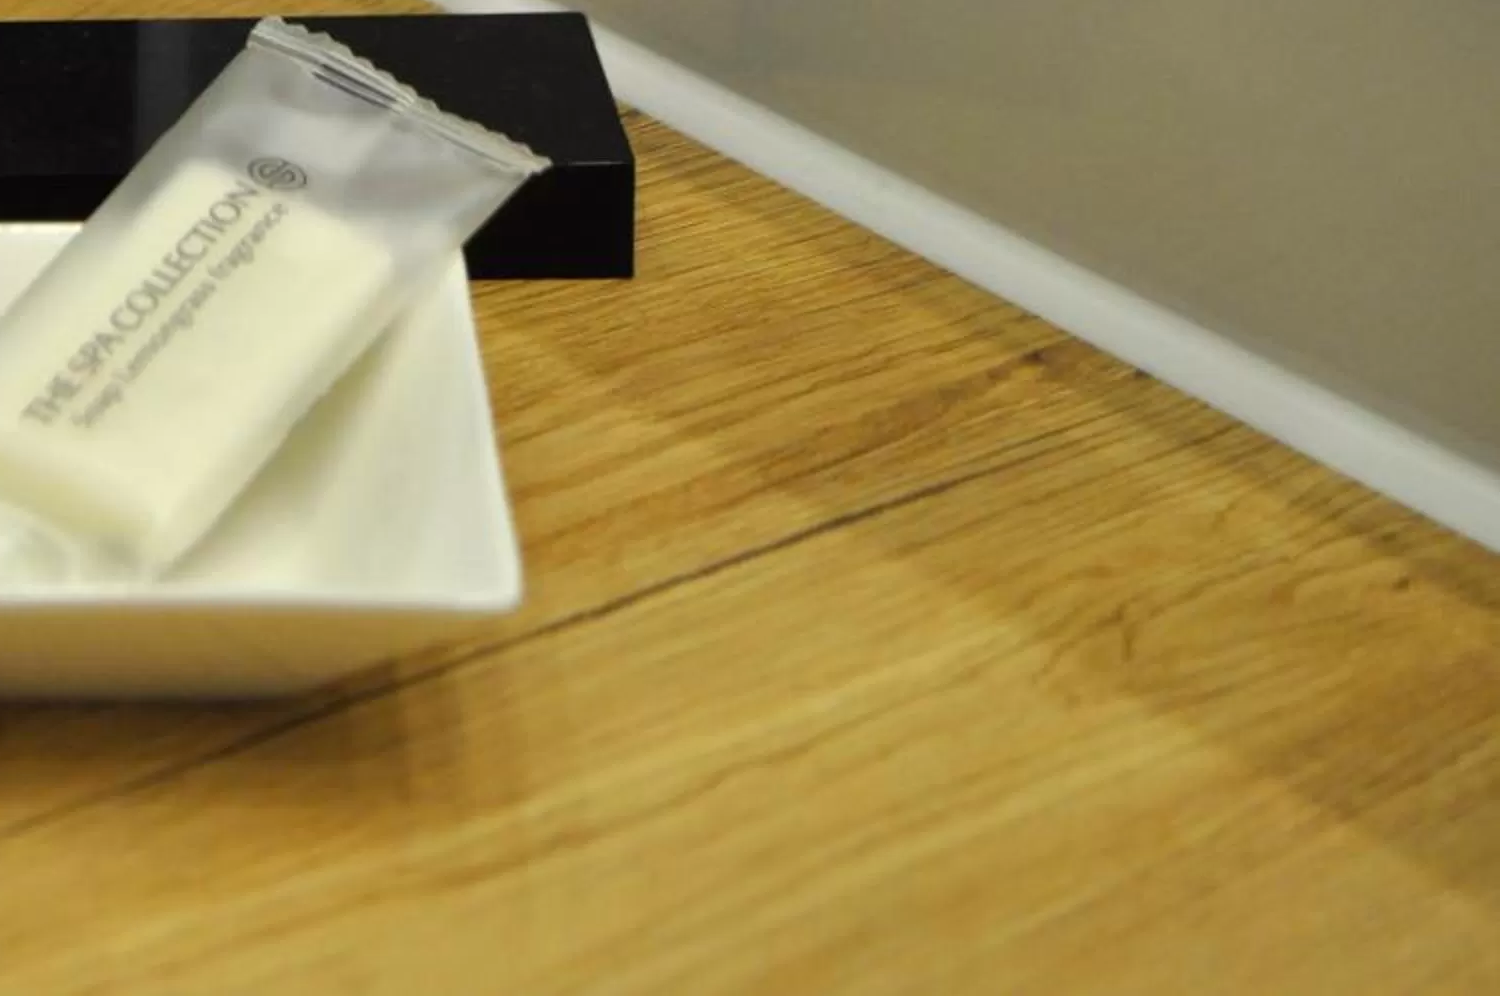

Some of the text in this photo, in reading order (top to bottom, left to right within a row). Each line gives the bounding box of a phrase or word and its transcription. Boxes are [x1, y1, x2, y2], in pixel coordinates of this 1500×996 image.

[20, 180, 259, 427] THE SPA COLLECTION
